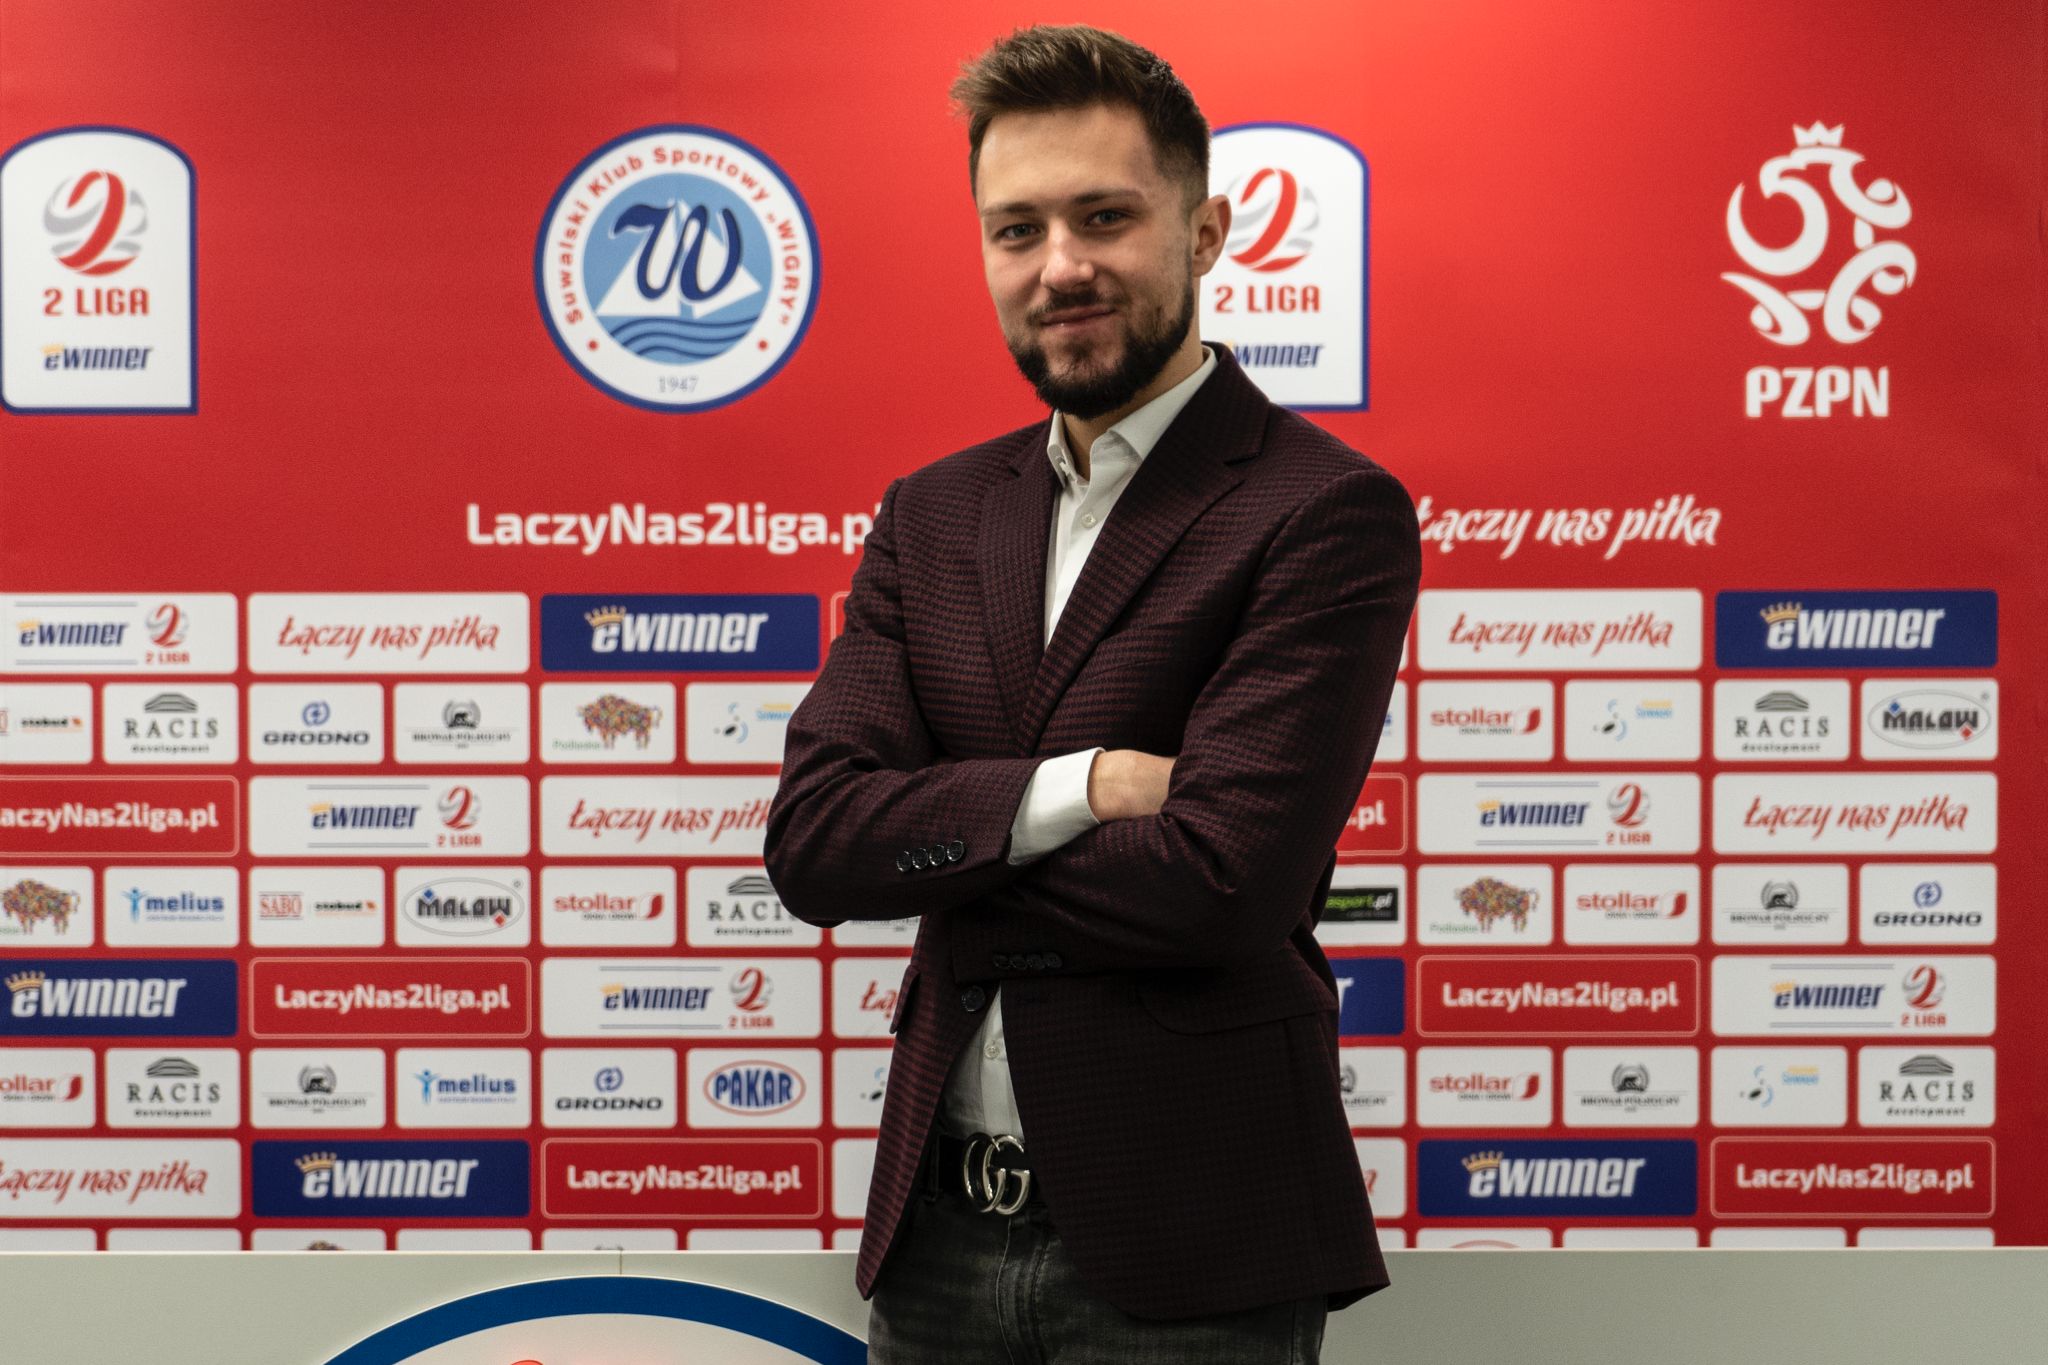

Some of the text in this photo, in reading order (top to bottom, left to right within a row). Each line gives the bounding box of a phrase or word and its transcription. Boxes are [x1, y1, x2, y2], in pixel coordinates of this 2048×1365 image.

[560, 201, 588, 324] Suwalski
[587, 154, 644, 198] Klub
[653, 146, 770, 203] Sportowy
[44, 288, 149, 316] 2 LIGA
[1215, 285, 1320, 313] 2 LIGA
[1234, 343, 1322, 368] winner
[659, 376, 698, 393] 1947
[1745, 366, 1889, 418] PZPN
[466, 503, 877, 555] LaczyNas2liga.p
[1536, 507, 1613, 546] nas
[1604, 495, 1721, 560] piłka
[278, 615, 500, 660] Łączy nas piłka
[592, 613, 768, 653] ewinner
[1449, 611, 1674, 657] Łączy nas piłka
[1767, 608, 1945, 650] ewinner
[124, 718, 218, 738] RACIS
[1430, 707, 1512, 726] stollar
[1735, 717, 1829, 737] RACIS
[263, 732, 370, 745] GRODNO
[0, 802, 219, 833] aczyNas2liga.pl
[567, 798, 768, 842] Łączy nas piłk
[1744, 794, 1969, 840] Łączy nas piłka
[145, 893, 224, 912] melius
[553, 893, 636, 912] stollar
[708, 902, 795, 922] RACI
[1576, 891, 1658, 910] stollar
[1874, 913, 1982, 926] GRODNO
[12, 977, 187, 1018] ewinner
[275, 984, 510, 1014] LaczyNas2liga.pl
[1443, 981, 1679, 1012] LaczyNas2liga.pl
[0, 1074, 54, 1092] ollar
[127, 1083, 220, 1103] RACIS
[436, 1075, 516, 1093] melius
[714, 1069, 793, 1107] PAKAR
[1429, 1072, 1512, 1091] stollar
[1880, 1081, 1974, 1101] RACIS
[556, 1098, 663, 1110] GRODNO
[79, 1169, 131, 1194] nas
[128, 1160, 208, 1204] piłka
[303, 1160, 478, 1198] ewinner
[567, 1165, 802, 1194] LaczyNas2liga.pl
[1468, 1158, 1645, 1197] ewinner
[1736, 1163, 1974, 1194] LaczyNas2liga.pl
